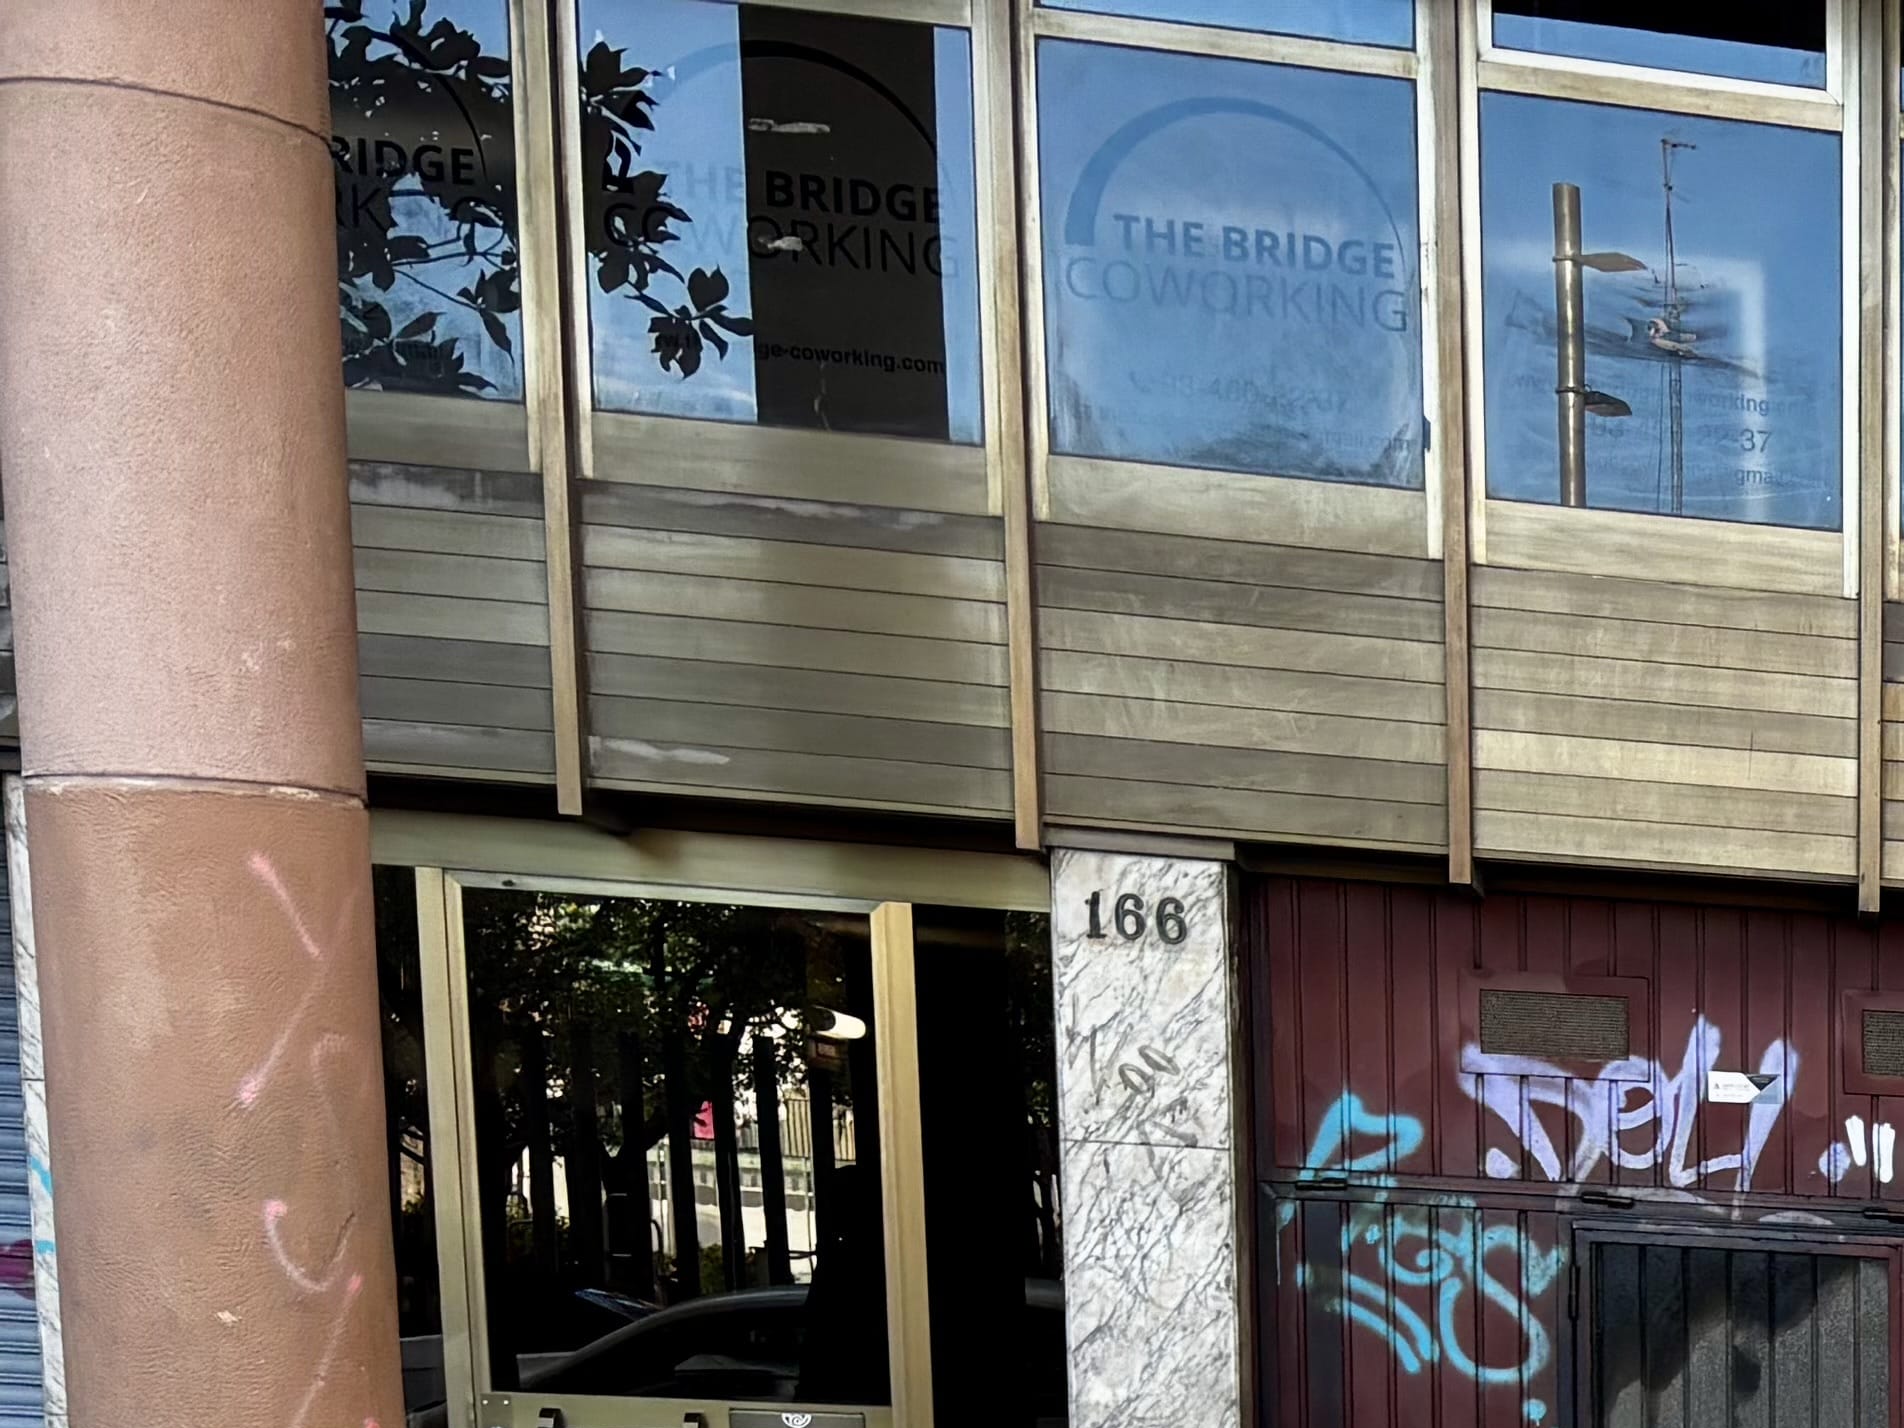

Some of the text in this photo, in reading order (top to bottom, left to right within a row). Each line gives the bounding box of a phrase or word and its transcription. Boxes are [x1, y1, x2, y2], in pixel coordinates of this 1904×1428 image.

[333, 135, 475, 186] RIDGE
[765, 170, 946, 224] BRIDGE
[1113, 213, 1396, 280] THE BRIDGE
[1065, 256, 1408, 333] COWORKING
[1085, 890, 1188, 945] 166
